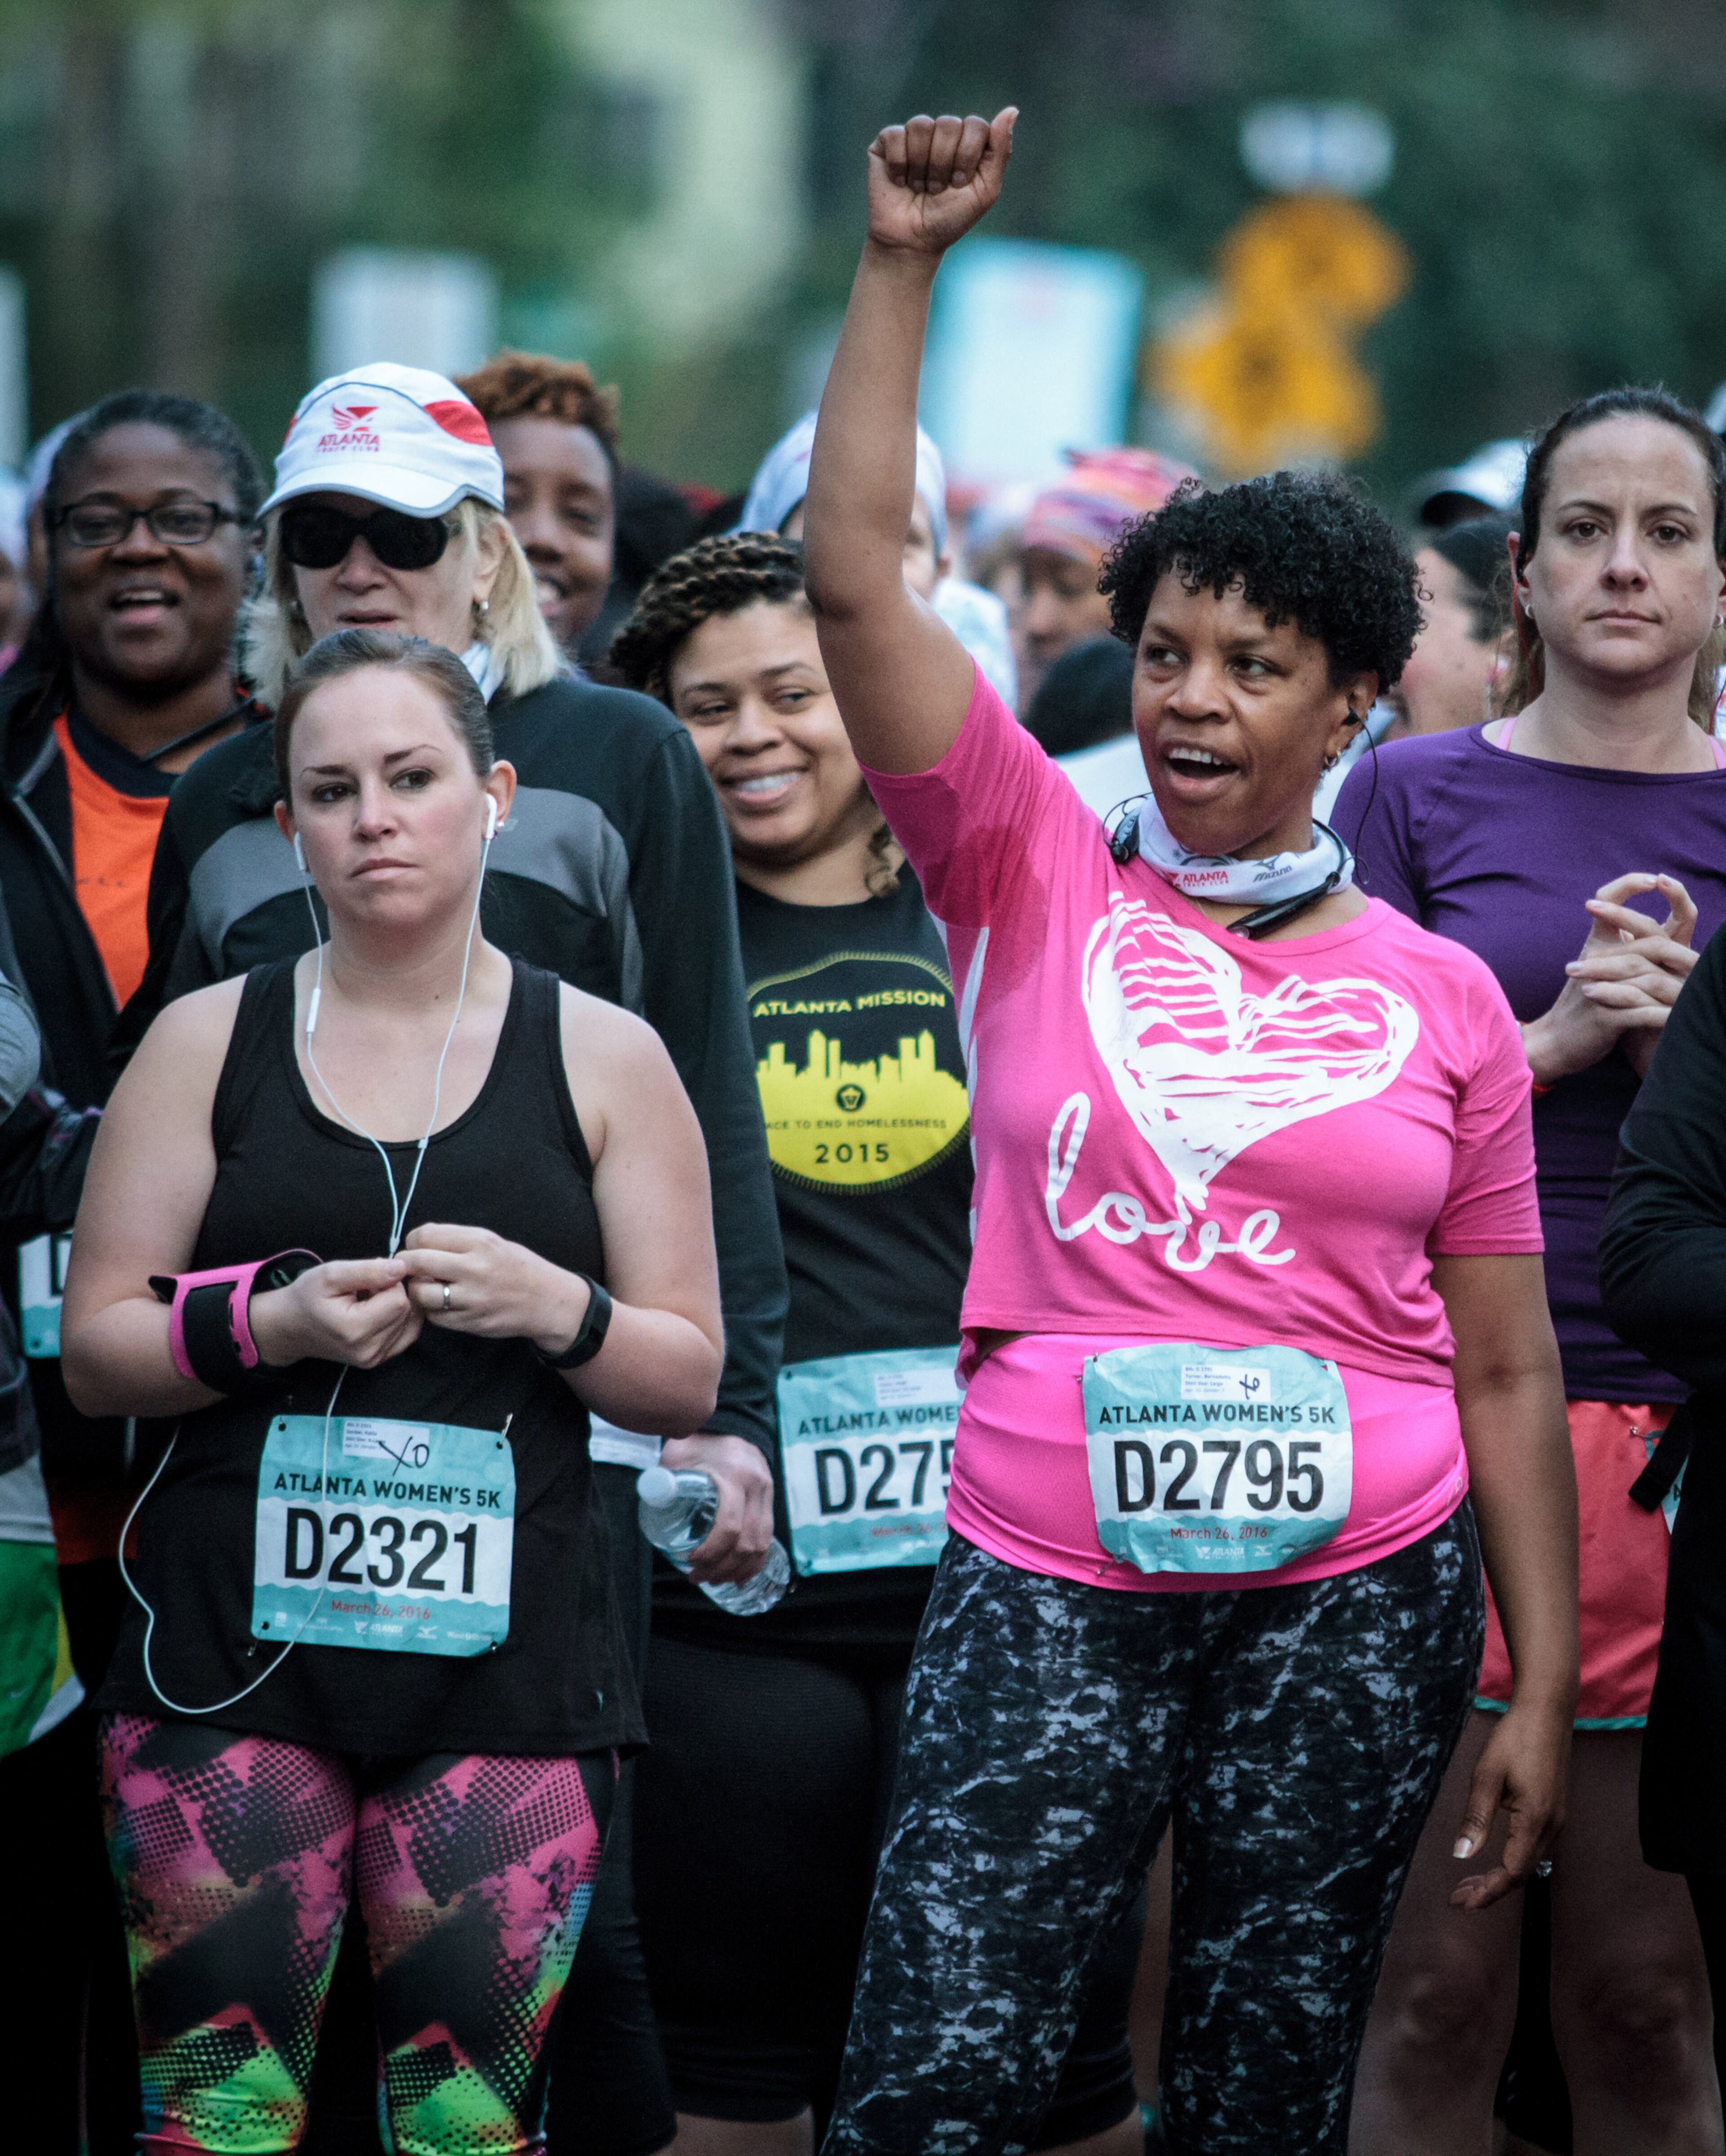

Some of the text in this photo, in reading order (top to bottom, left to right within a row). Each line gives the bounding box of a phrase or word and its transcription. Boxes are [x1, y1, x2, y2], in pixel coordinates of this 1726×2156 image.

[319, 434, 380, 446] ATLANTA
[1183, 871, 1228, 883] ATLANTA
[754, 989, 945, 1017] ATLANTA MISSION
[765, 1118, 948, 1129] ACE TO END HOMELESSNESS
[815, 1143, 889, 1163] 2015
[799, 1405, 959, 1435] ATLANTA WOME
[1099, 1404, 1335, 1424] ATLANTA WOMEN'S 5K
[1114, 1439, 1324, 1513] D2795
[274, 1472, 501, 1509] ATLANTA WOMEN'S 5K
[1170, 1526, 1268, 1541] March 26, 2016
[284, 1507, 478, 1594] D2321
[331, 1599, 430, 1620] March 26, 2016
